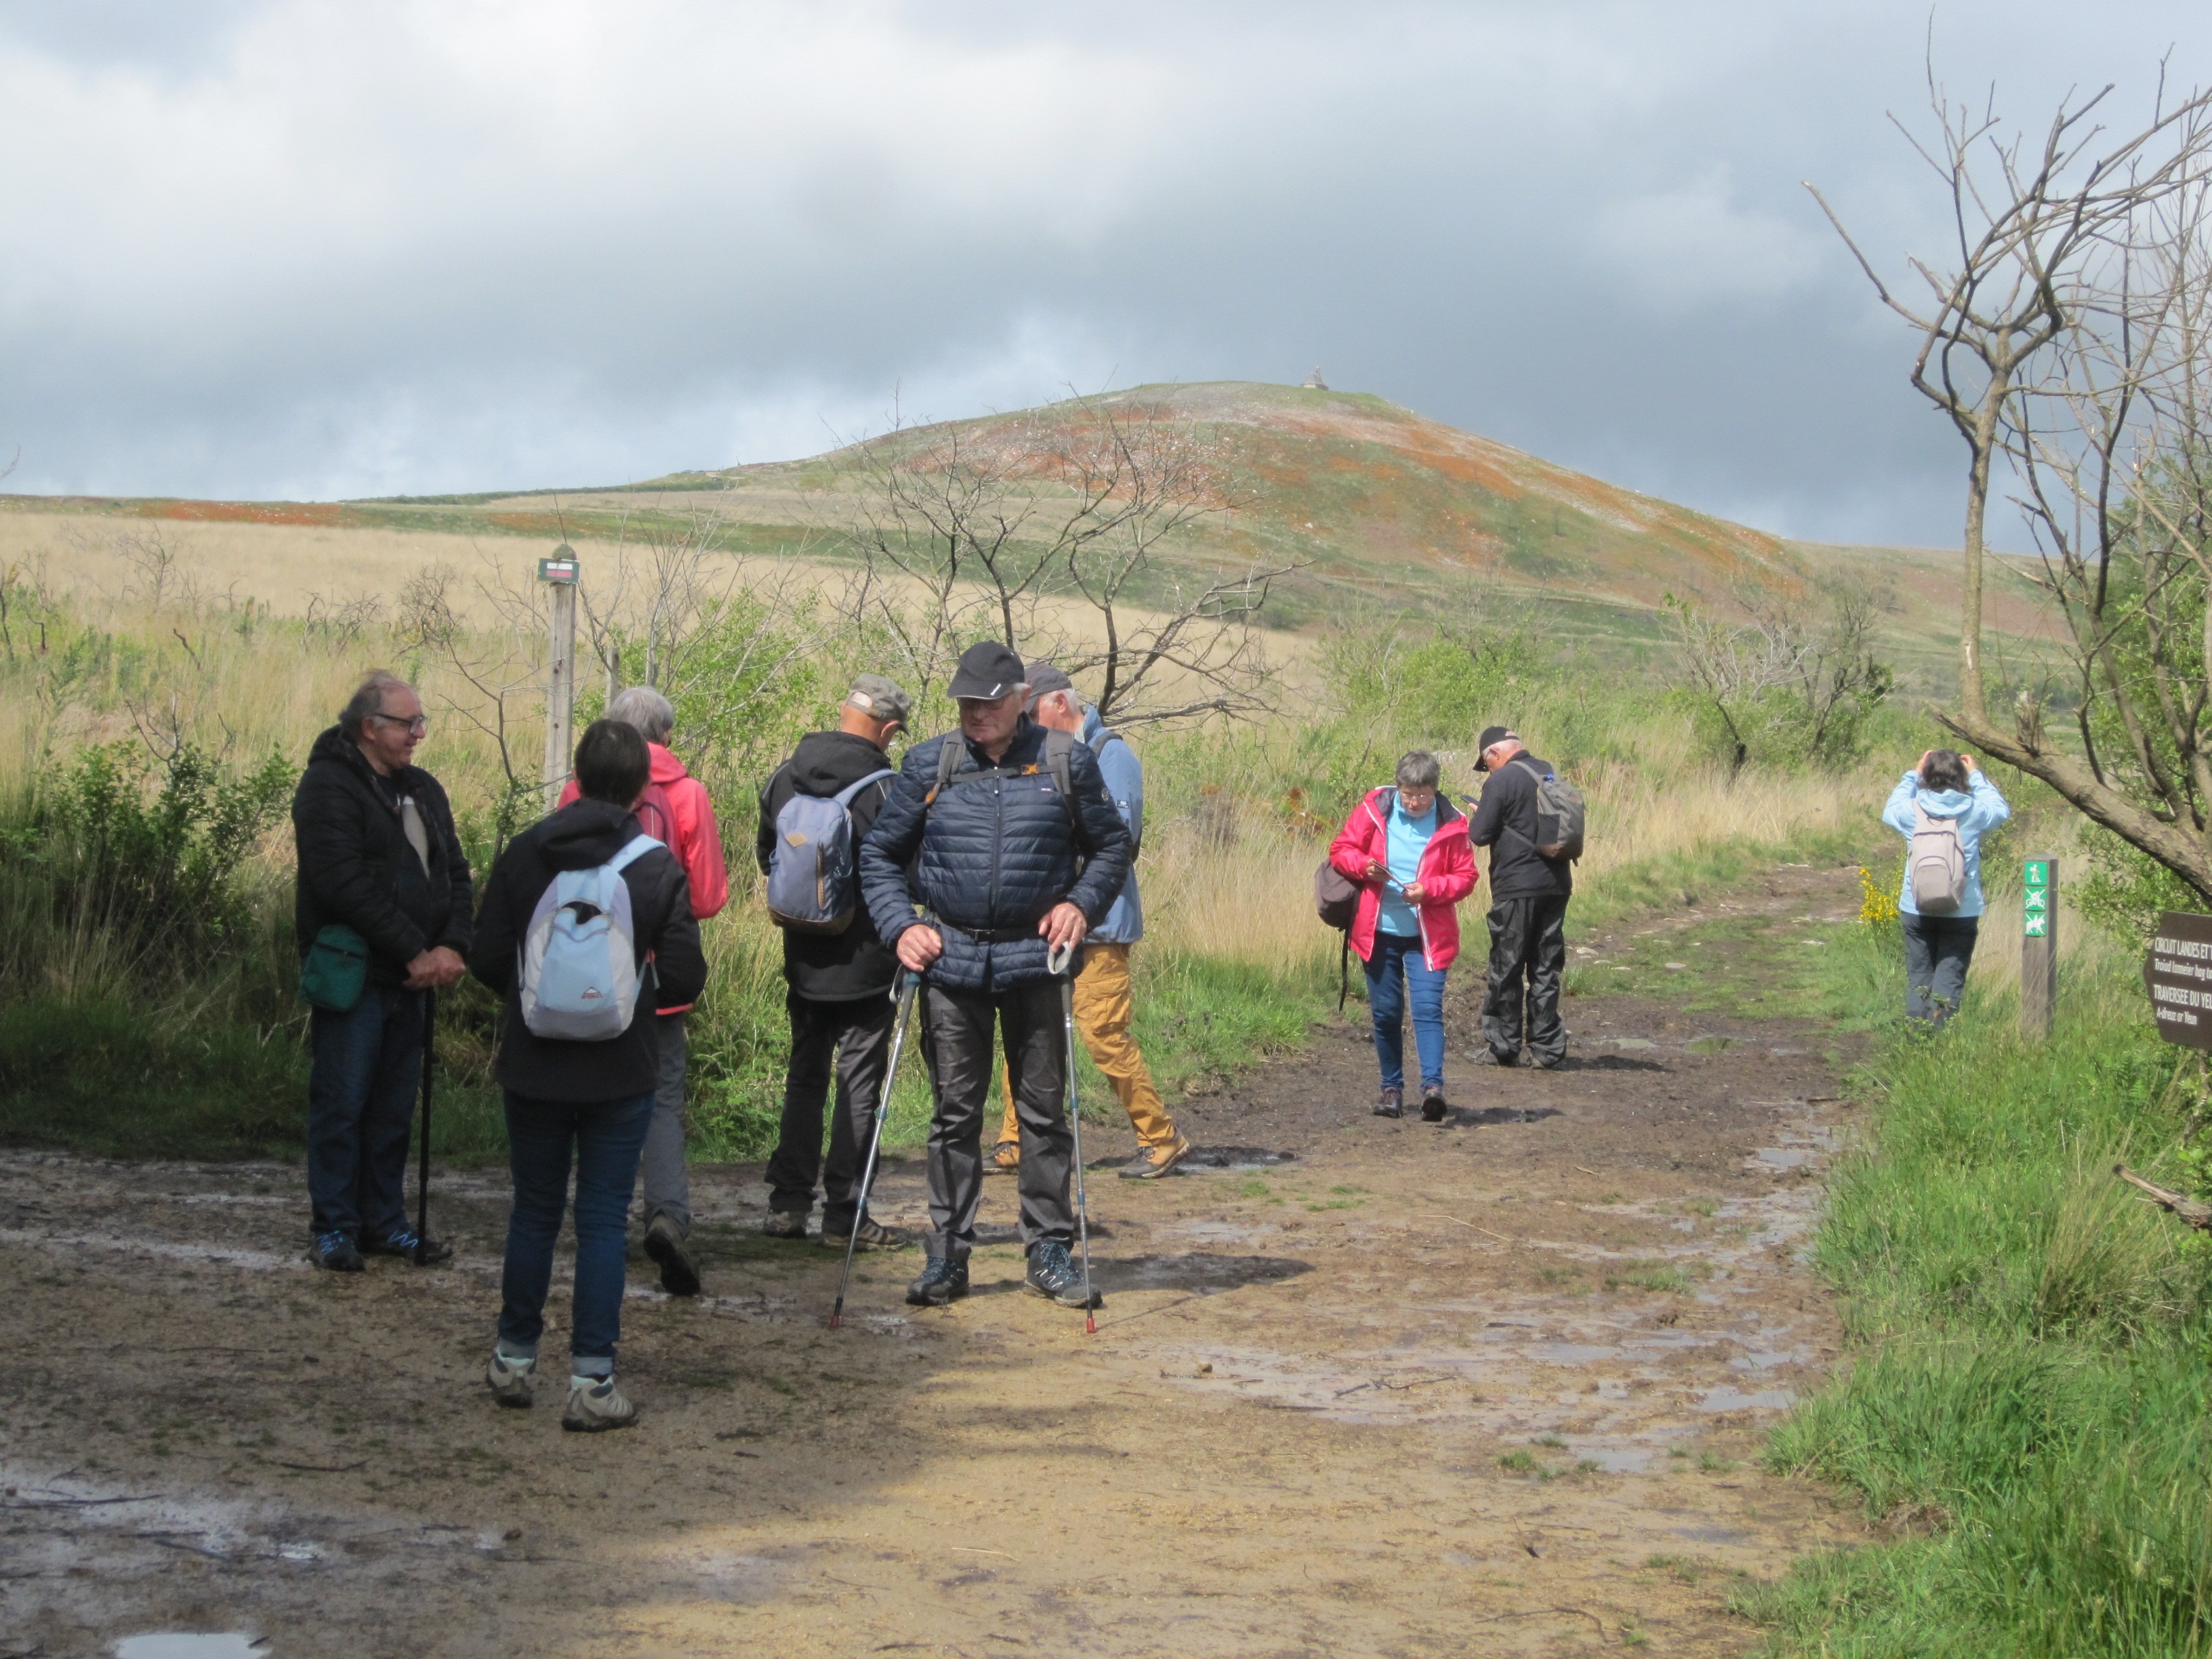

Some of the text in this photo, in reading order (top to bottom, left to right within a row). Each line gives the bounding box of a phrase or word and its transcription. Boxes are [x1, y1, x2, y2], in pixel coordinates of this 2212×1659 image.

[2154, 937, 2175, 954] CIRCUIT
[2177, 939, 2199, 958] LANDES
[2200, 943, 2210, 960] ET
[2190, 990, 2200, 1007] DU
